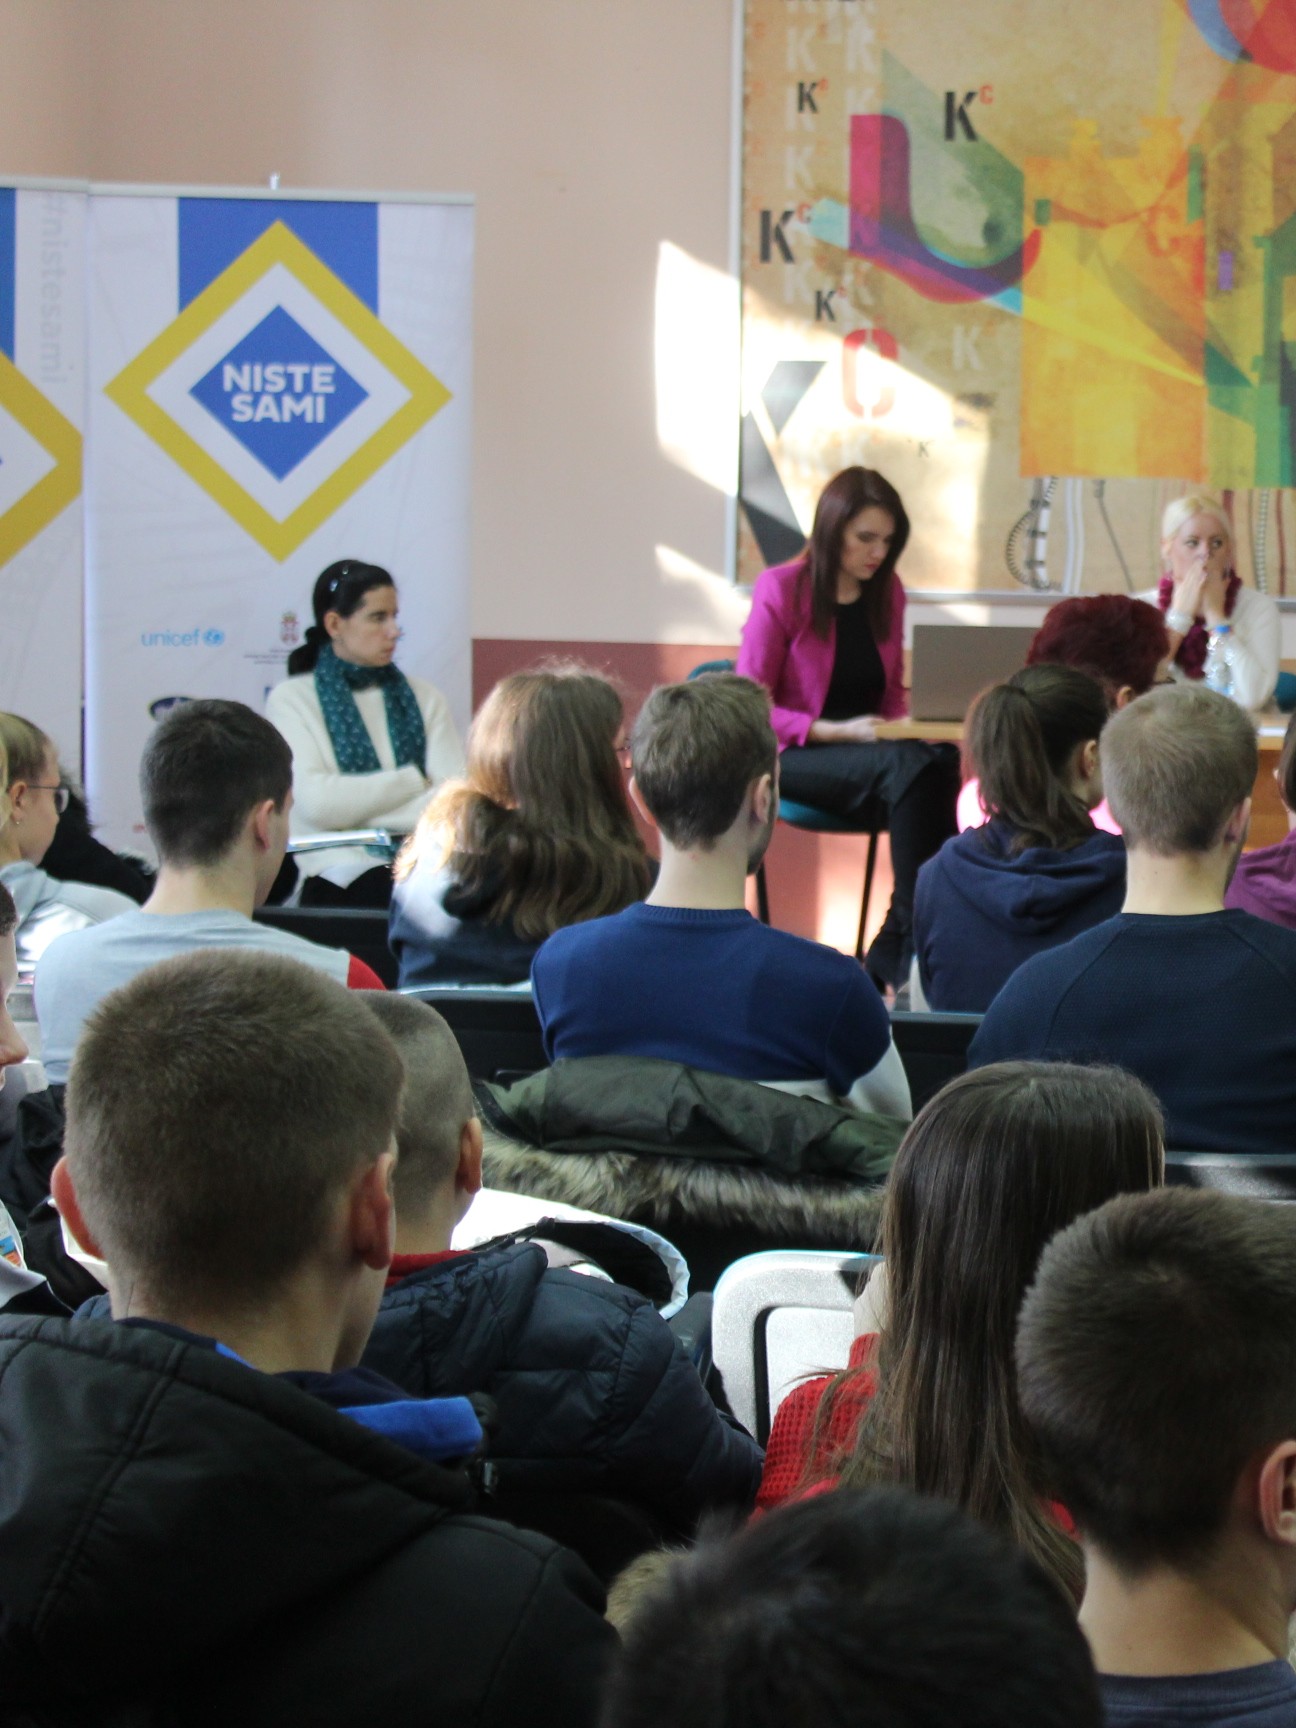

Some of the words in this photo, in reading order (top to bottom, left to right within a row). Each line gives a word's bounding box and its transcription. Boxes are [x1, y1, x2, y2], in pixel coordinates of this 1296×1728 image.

[223, 363, 336, 393] NISTE
[231, 394, 325, 423] SAMI
[141, 628, 200, 647] unicef
